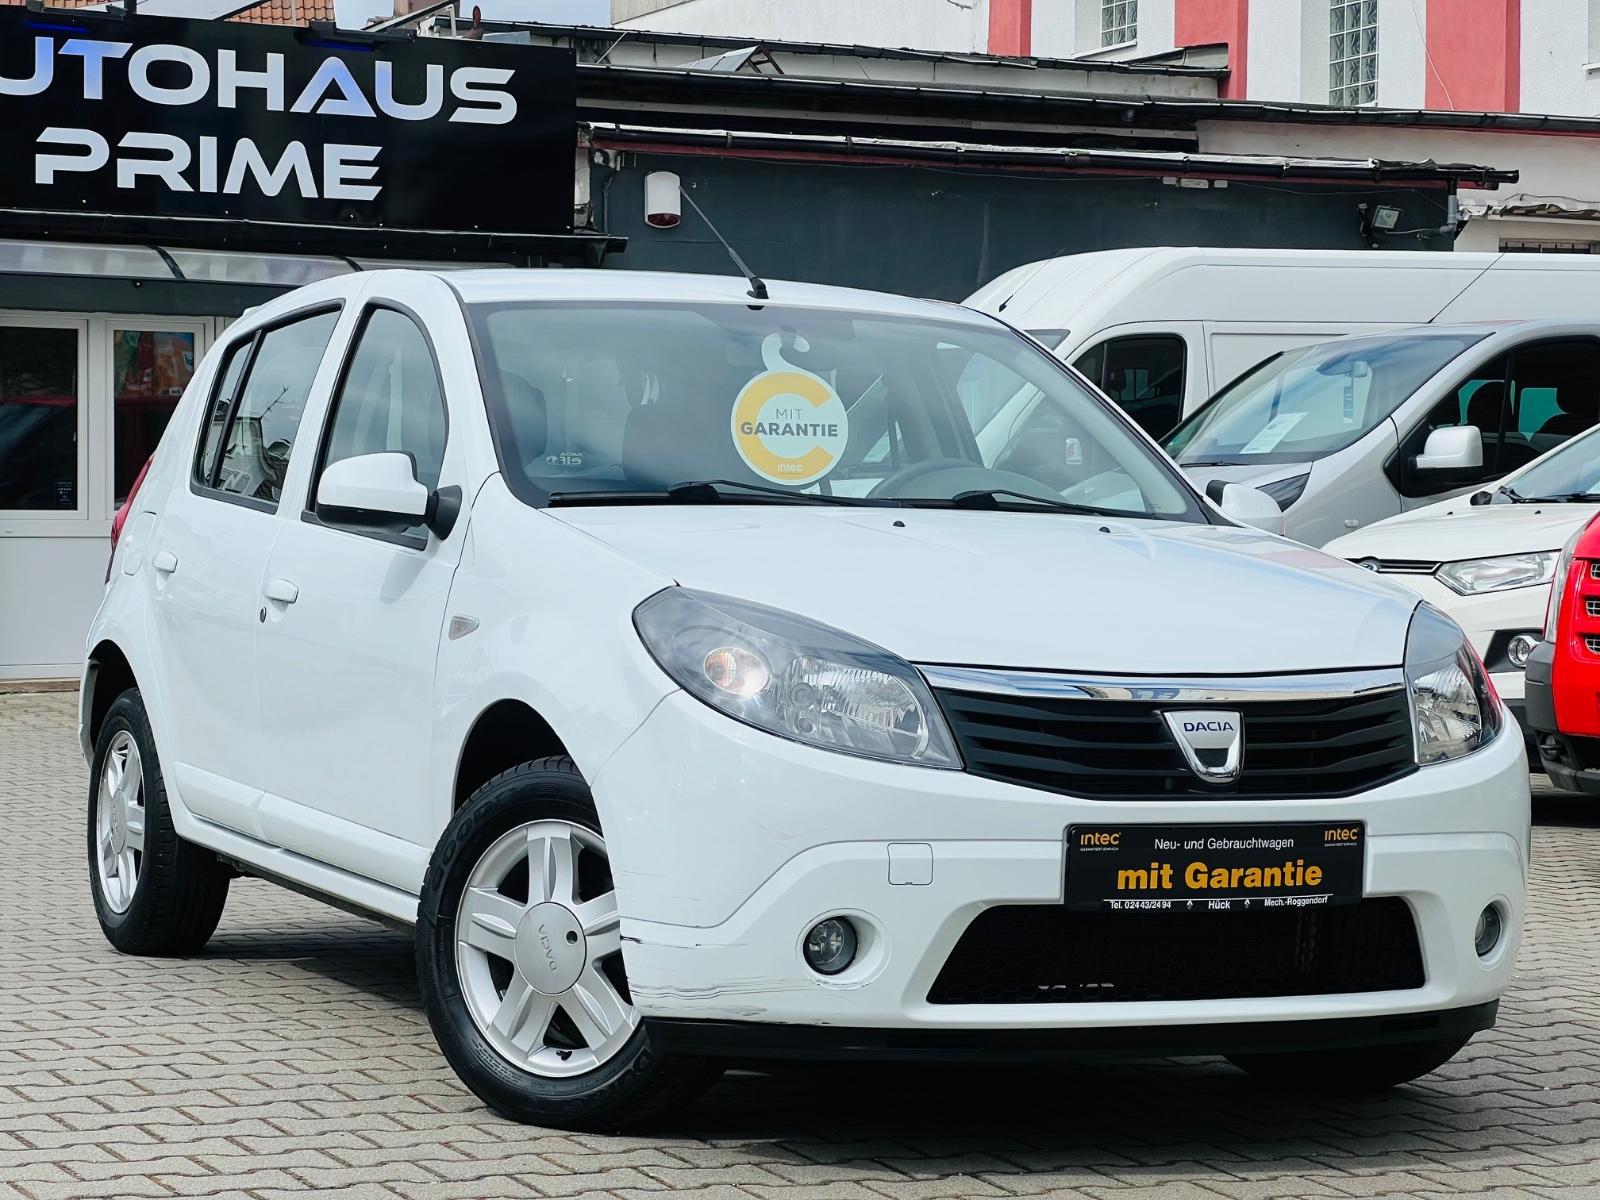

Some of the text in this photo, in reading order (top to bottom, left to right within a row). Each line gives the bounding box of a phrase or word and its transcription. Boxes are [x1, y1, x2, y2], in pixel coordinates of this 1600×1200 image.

[35, 126, 383, 200] PRIME
[775, 408, 803, 420] MIT
[740, 421, 838, 438] GARANTIE
[1183, 721, 1234, 732] DACIA
[1080, 832, 1120, 846] intec
[1324, 828, 1358, 841] intec
[1154, 837, 1294, 851] Neu- und Gebrauchtwagen
[1117, 859, 1323, 890] mit Garantie
[1110, 901, 1123, 909] Tel.
[1208, 899, 1231, 910] Hück
[1264, 895, 1328, 907] Mech.-Roggendorf
